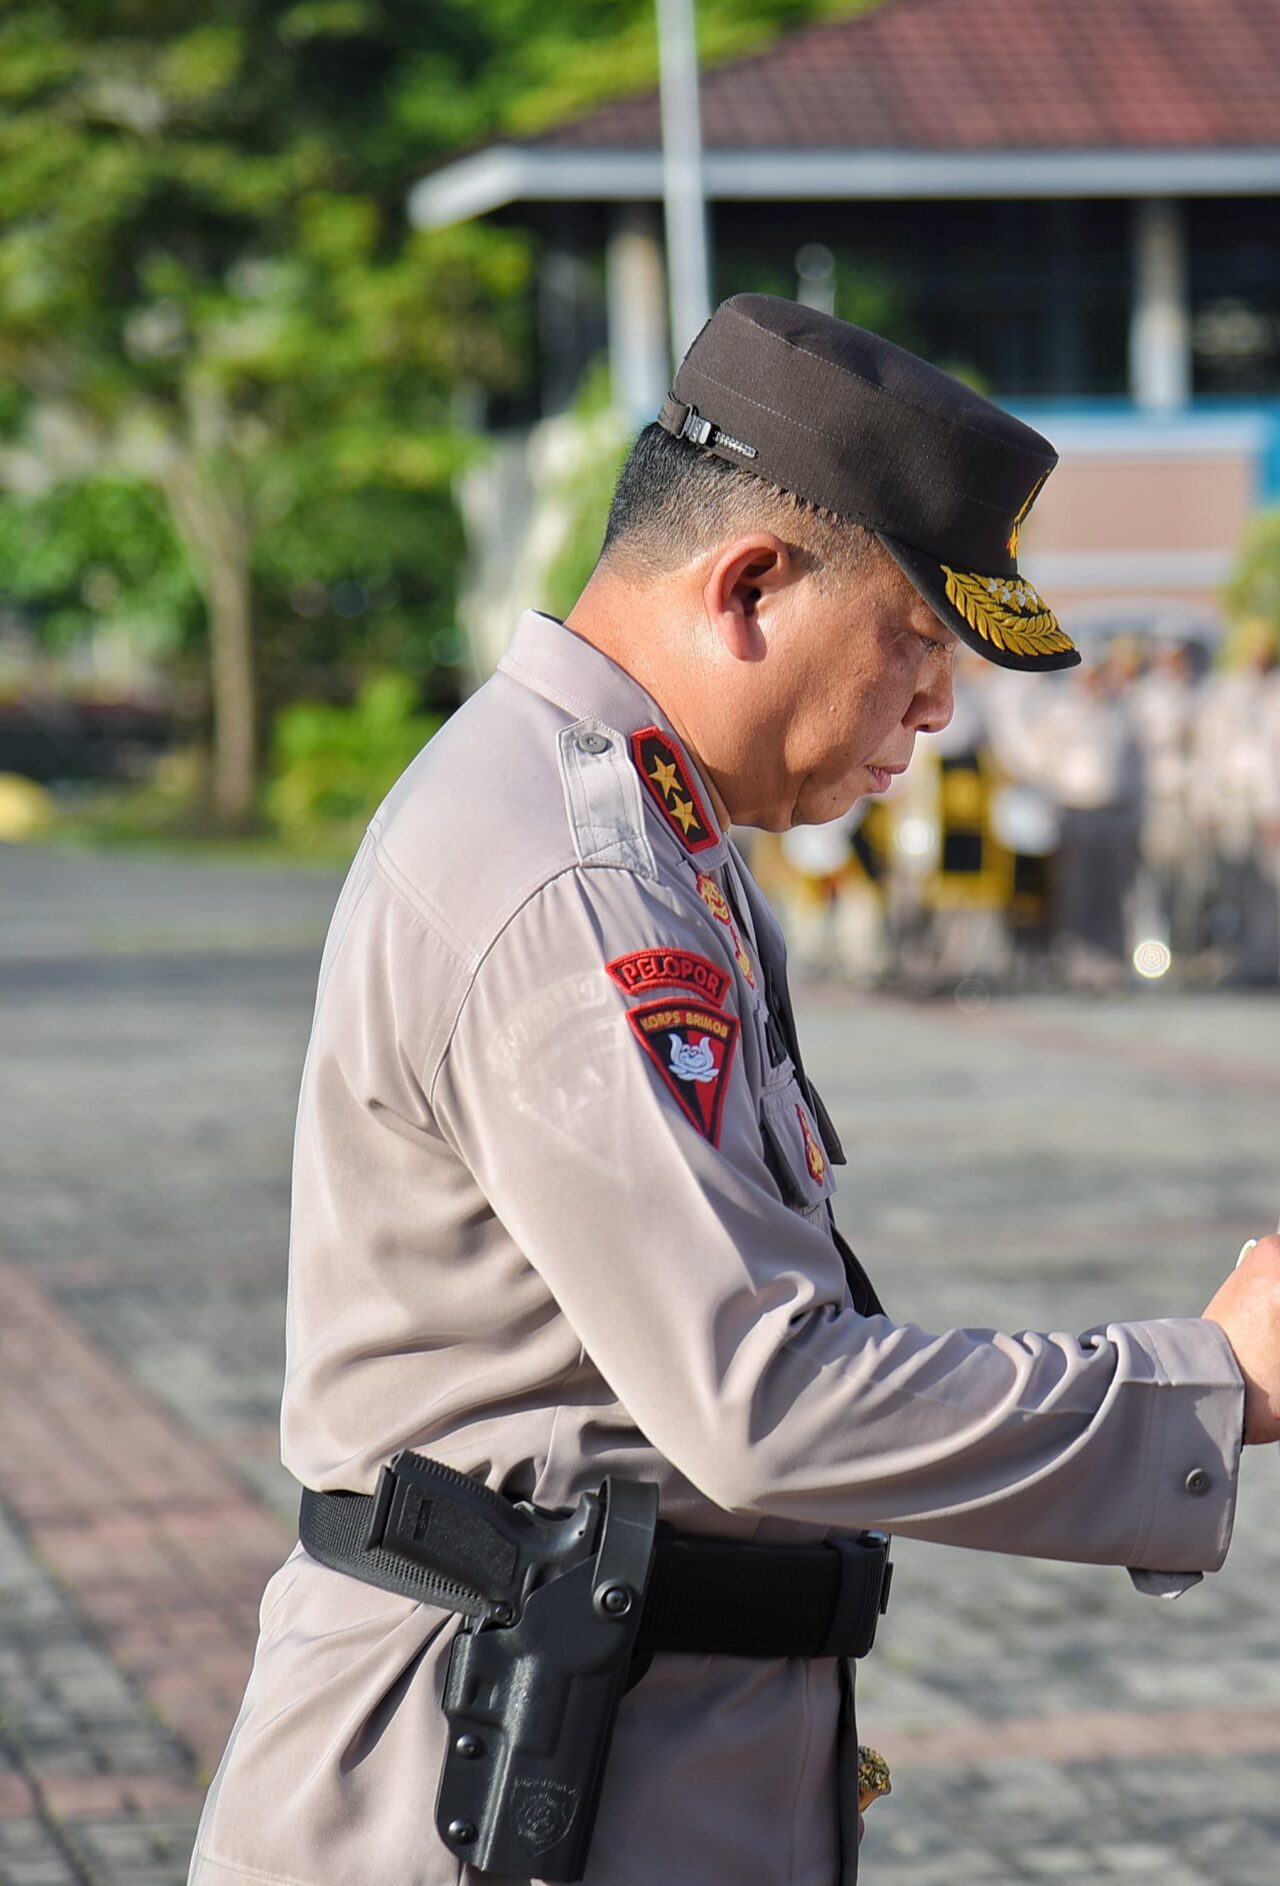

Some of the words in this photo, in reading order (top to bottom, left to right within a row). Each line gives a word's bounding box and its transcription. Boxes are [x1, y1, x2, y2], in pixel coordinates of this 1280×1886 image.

[621, 956, 720, 995] PELOPOR
[641, 1011, 681, 1031] KORPS
[685, 1012, 729, 1038] BRIMOB
